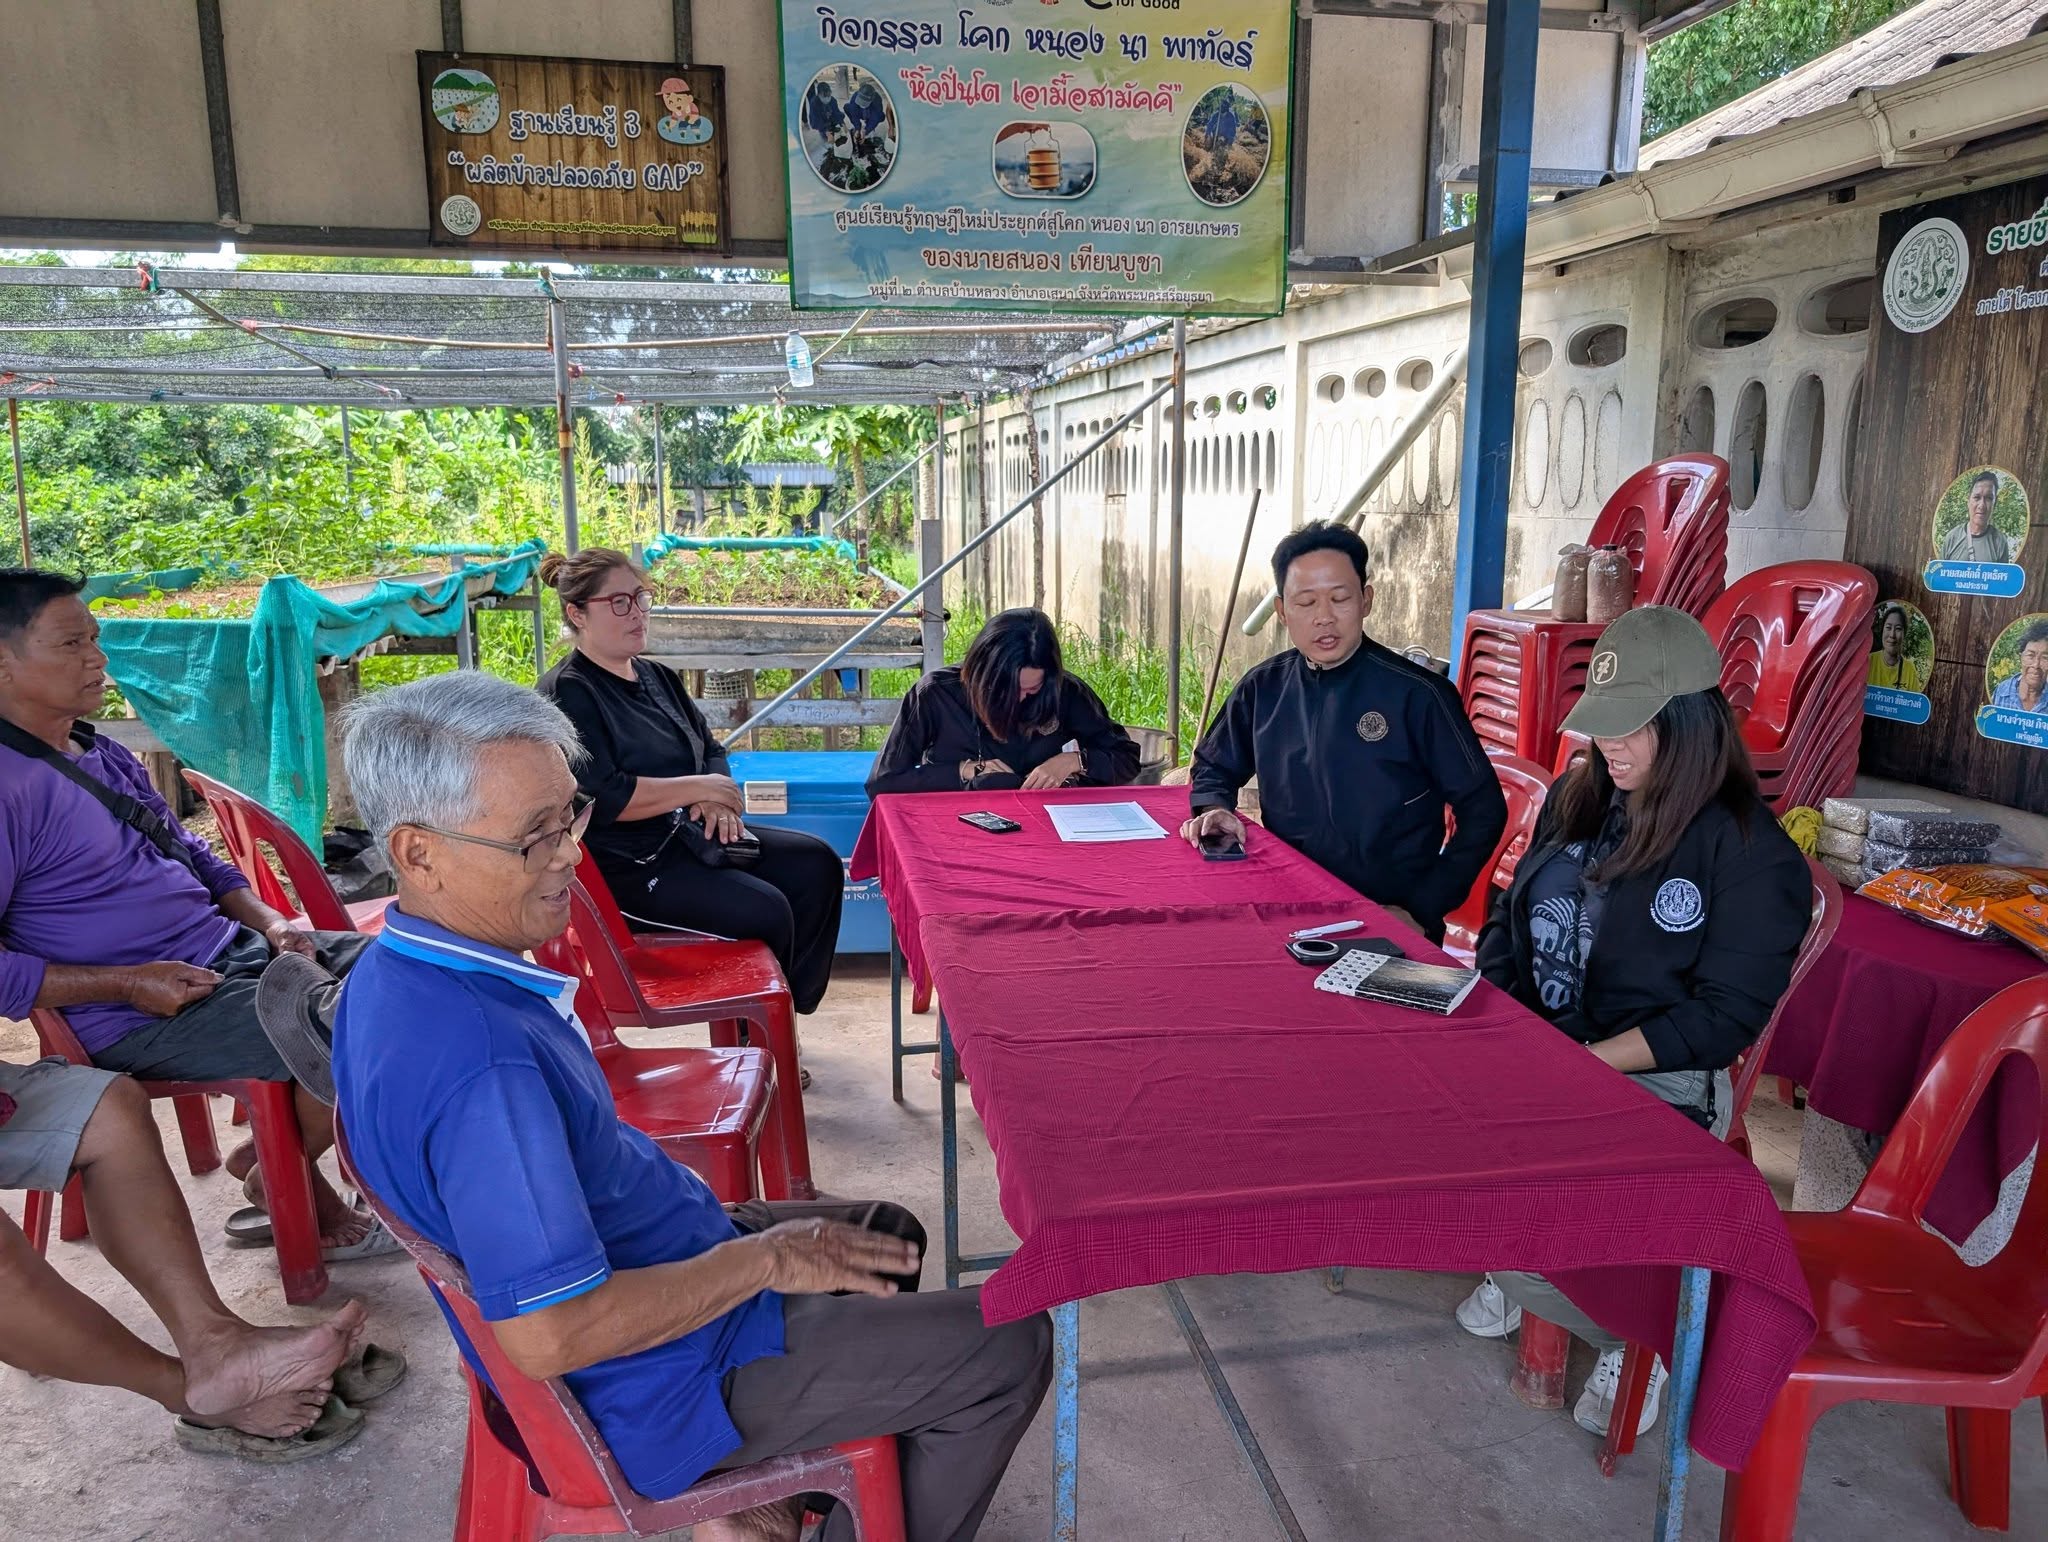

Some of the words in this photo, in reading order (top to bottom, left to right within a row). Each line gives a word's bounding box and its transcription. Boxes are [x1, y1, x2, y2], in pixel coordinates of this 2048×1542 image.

[816, 6, 943, 54] กิจกรรม
[958, 9, 1010, 53] โคก
[1025, 24, 1105, 60] หนอง
[1119, 33, 1148, 62] นา
[1162, 28, 1258, 72] พาทัวร์
[510, 104, 617, 147] ฐานเรียนรู้
[624, 111, 641, 138] 3
[1090, 216, 1130, 233] หนอง
[1136, 219, 1155, 234] นา
[1159, 220, 1240, 237] อารยเกษตร
[922, 248, 1062, 271] ของนายสนอง
[1070, 245, 1162, 281] เทียนบูชา
[868, 279, 898, 301] หมู่ที่
[916, 280, 1006, 299] ตำบลบ้านหลวง
[1011, 284, 1075, 301] อำเภอเสนา
[1078, 284, 1213, 307] จังหวัดพระนครศรีอยุธยา
[1976, 287, 2013, 316] ภายใต้
